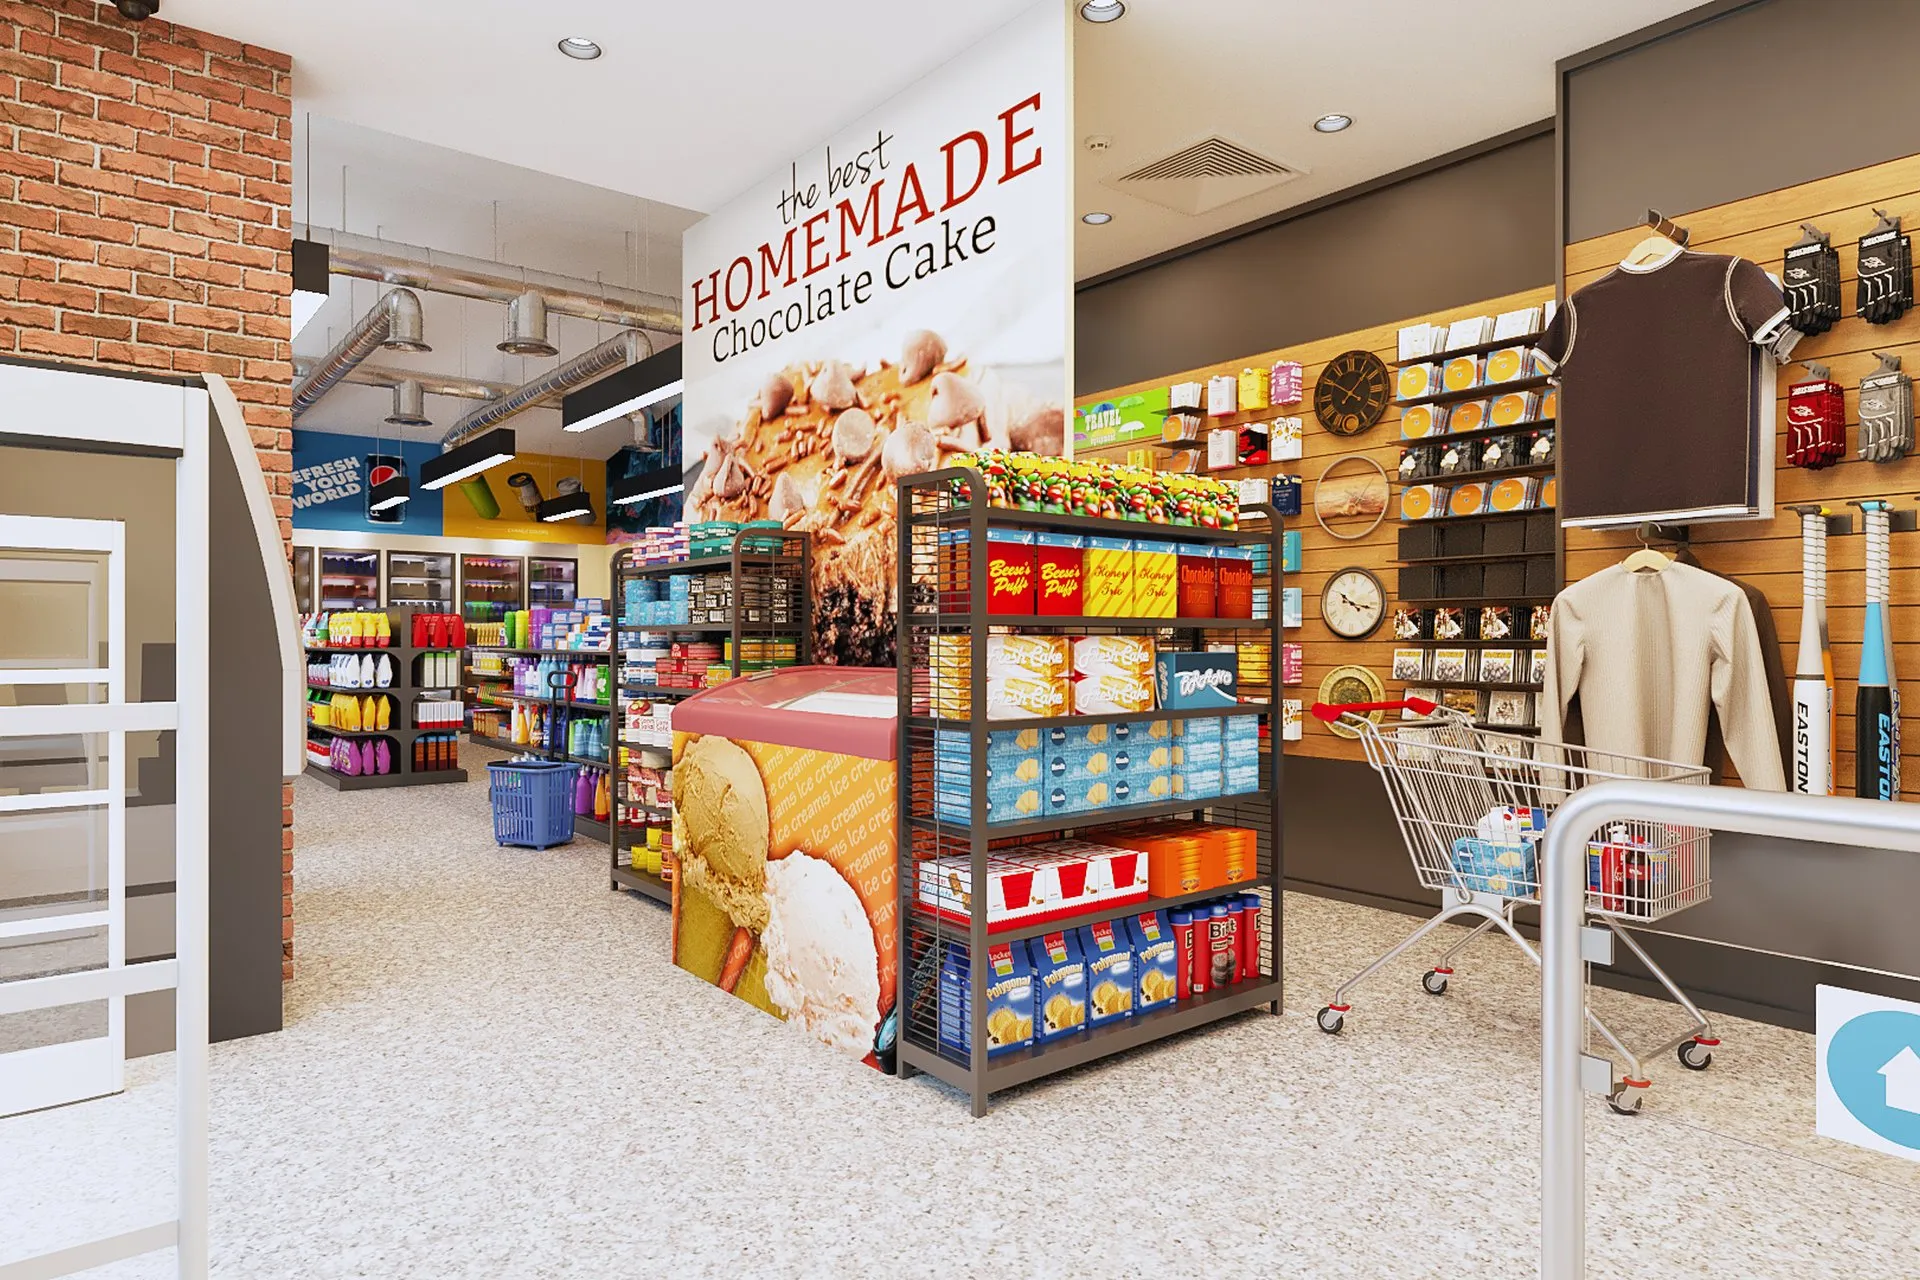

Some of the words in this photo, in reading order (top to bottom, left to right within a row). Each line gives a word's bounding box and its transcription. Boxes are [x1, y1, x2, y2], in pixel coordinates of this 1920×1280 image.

[777, 162, 821, 224] the
[828, 131, 894, 198] best
[691, 92, 1043, 332] HOMEMADE
[713, 271, 872, 362] Chocolate
[886, 214, 996, 289] Cake
[1085, 408, 1121, 432] TRAVEL
[291, 456, 360, 484] EFRESH
[304, 470, 361, 492] YOUR
[292, 483, 361, 509] WORLD
[989, 559, 1031, 578] Beese's
[1041, 562, 1080, 580] Beese's
[1093, 563, 1130, 584] Honey
[1139, 566, 1174, 586] Honey
[1181, 565, 1214, 584] Chocolate
[1219, 567, 1252, 586] Chocolate
[993, 577, 1029, 597] Puffs
[1044, 579, 1079, 598] Puffs
[1187, 585, 1209, 605] Dream
[1030, 645, 1064, 668] Cake
[1079, 646, 1122, 667] Fresh
[1121, 644, 1150, 666] Cake
[1031, 685, 1064, 708] Cake
[1081, 686, 1122, 707] Fresh
[1121, 683, 1150, 704] Cake
[1796, 701, 1809, 794] EASTON
[796, 777, 814, 798] Ice
[773, 824, 790, 845] Ice
[791, 790, 831, 831] creams
[830, 775, 850, 798] Ice
[811, 824, 830, 846] Ice
[831, 789, 875, 832] creams
[874, 771, 897, 797] Ice
[847, 823, 868, 848] Ice
[843, 840, 888, 881] creams
[858, 877, 880, 898] Ice
[1090, 951, 1130, 975] Polygonal
[1140, 940, 1174, 964] Polygonal
[1043, 963, 1084, 988] Polygonal
[986, 976, 1031, 1001] Polygonal
